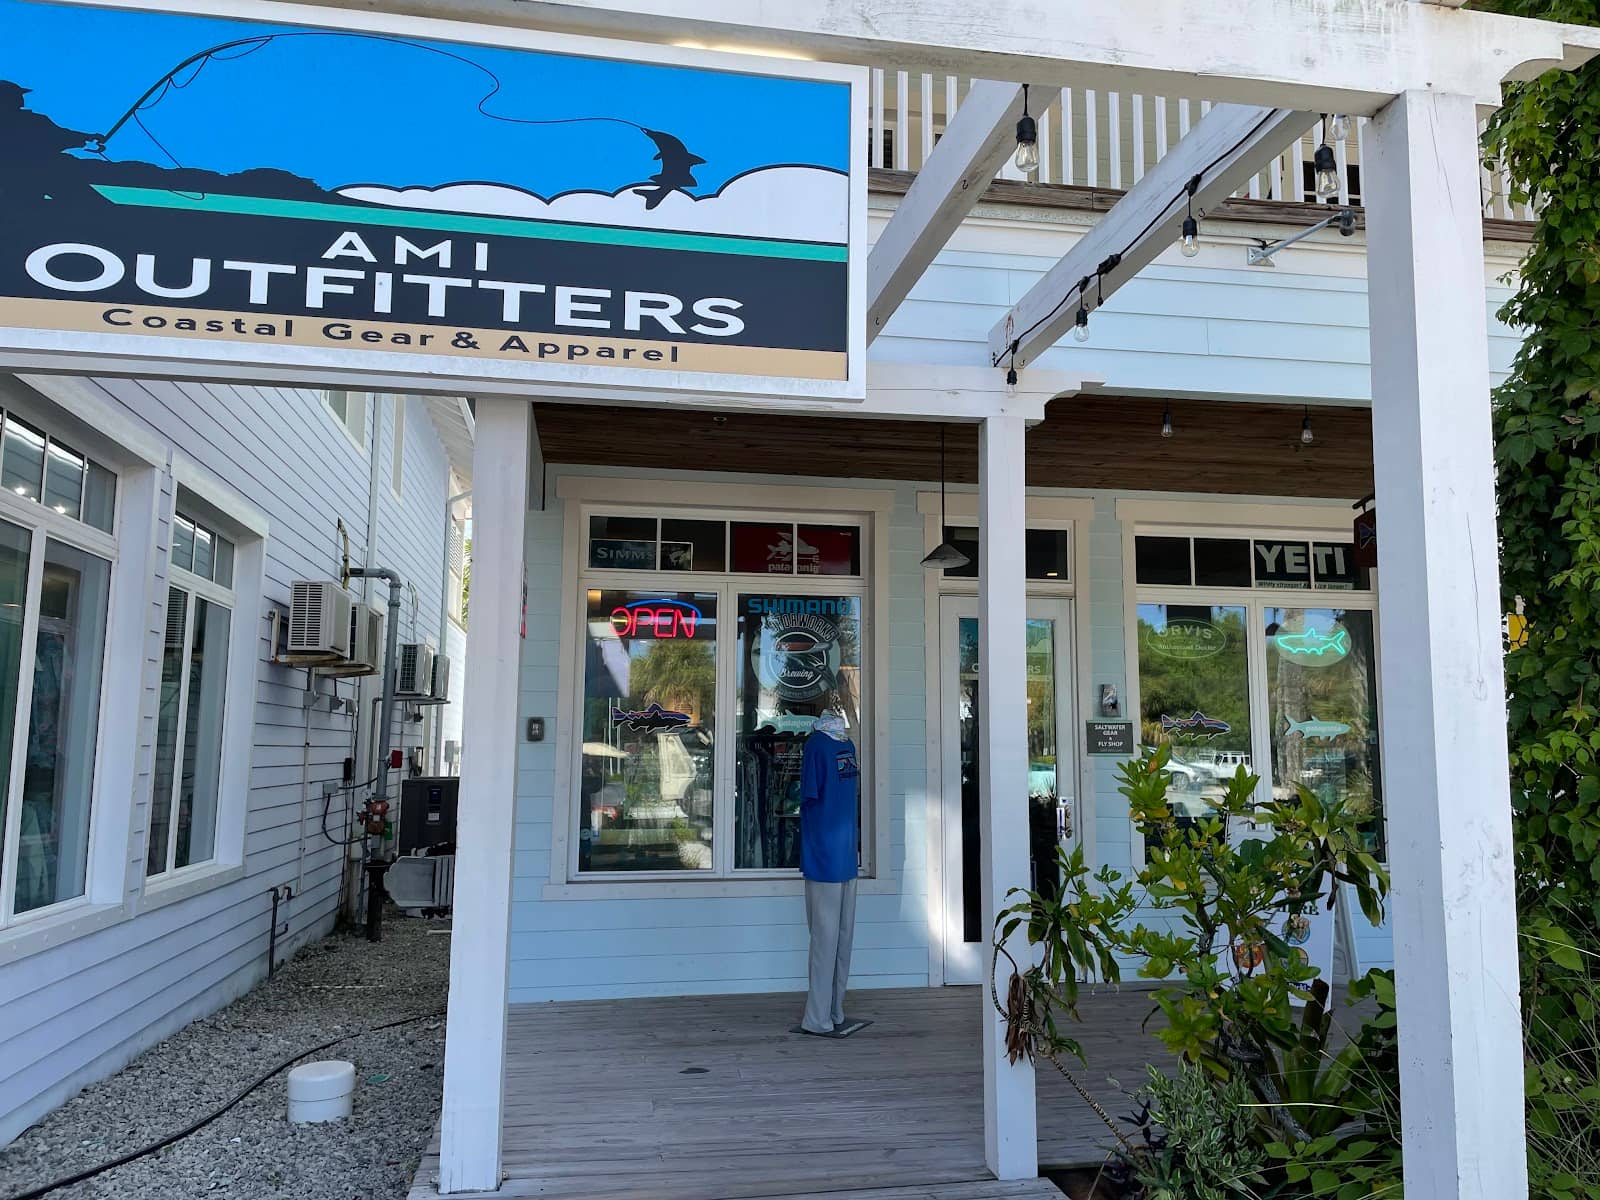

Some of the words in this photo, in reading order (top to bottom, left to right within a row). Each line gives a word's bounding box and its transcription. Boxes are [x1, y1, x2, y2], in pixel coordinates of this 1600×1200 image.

[321, 231, 488, 271] AMI
[25, 243, 745, 336] OUTFITTERS
[102, 308, 294, 337] Coastal
[321, 323, 435, 346] Gear
[450, 331, 481, 350] &
[499, 335, 679, 363] Apparel
[597, 547, 655, 561] SIMMS
[1255, 544, 1346, 575] YETI
[768, 563, 820, 573] pataonia
[747, 597, 850, 615] SHIMANO
[609, 606, 696, 638] OPEN
[779, 668, 814, 680] Brewing
[778, 719, 815, 728] patagoni
